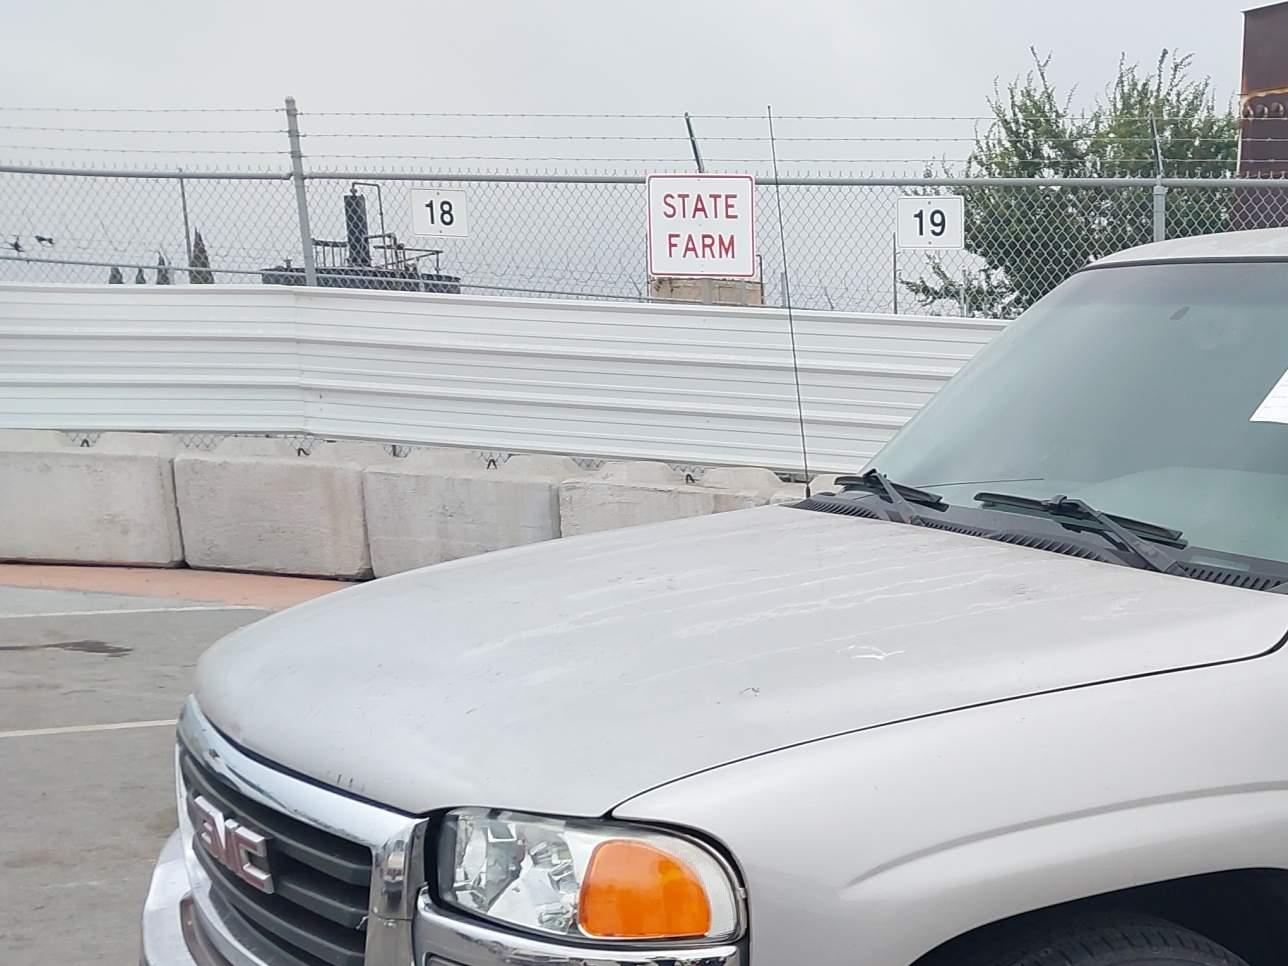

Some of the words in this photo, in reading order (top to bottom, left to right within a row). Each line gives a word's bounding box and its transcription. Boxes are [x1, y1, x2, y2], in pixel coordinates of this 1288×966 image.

[425, 199, 454, 226] 18
[663, 193, 738, 219] STATE
[913, 209, 946, 237] 19
[668, 233, 735, 259] FARM
